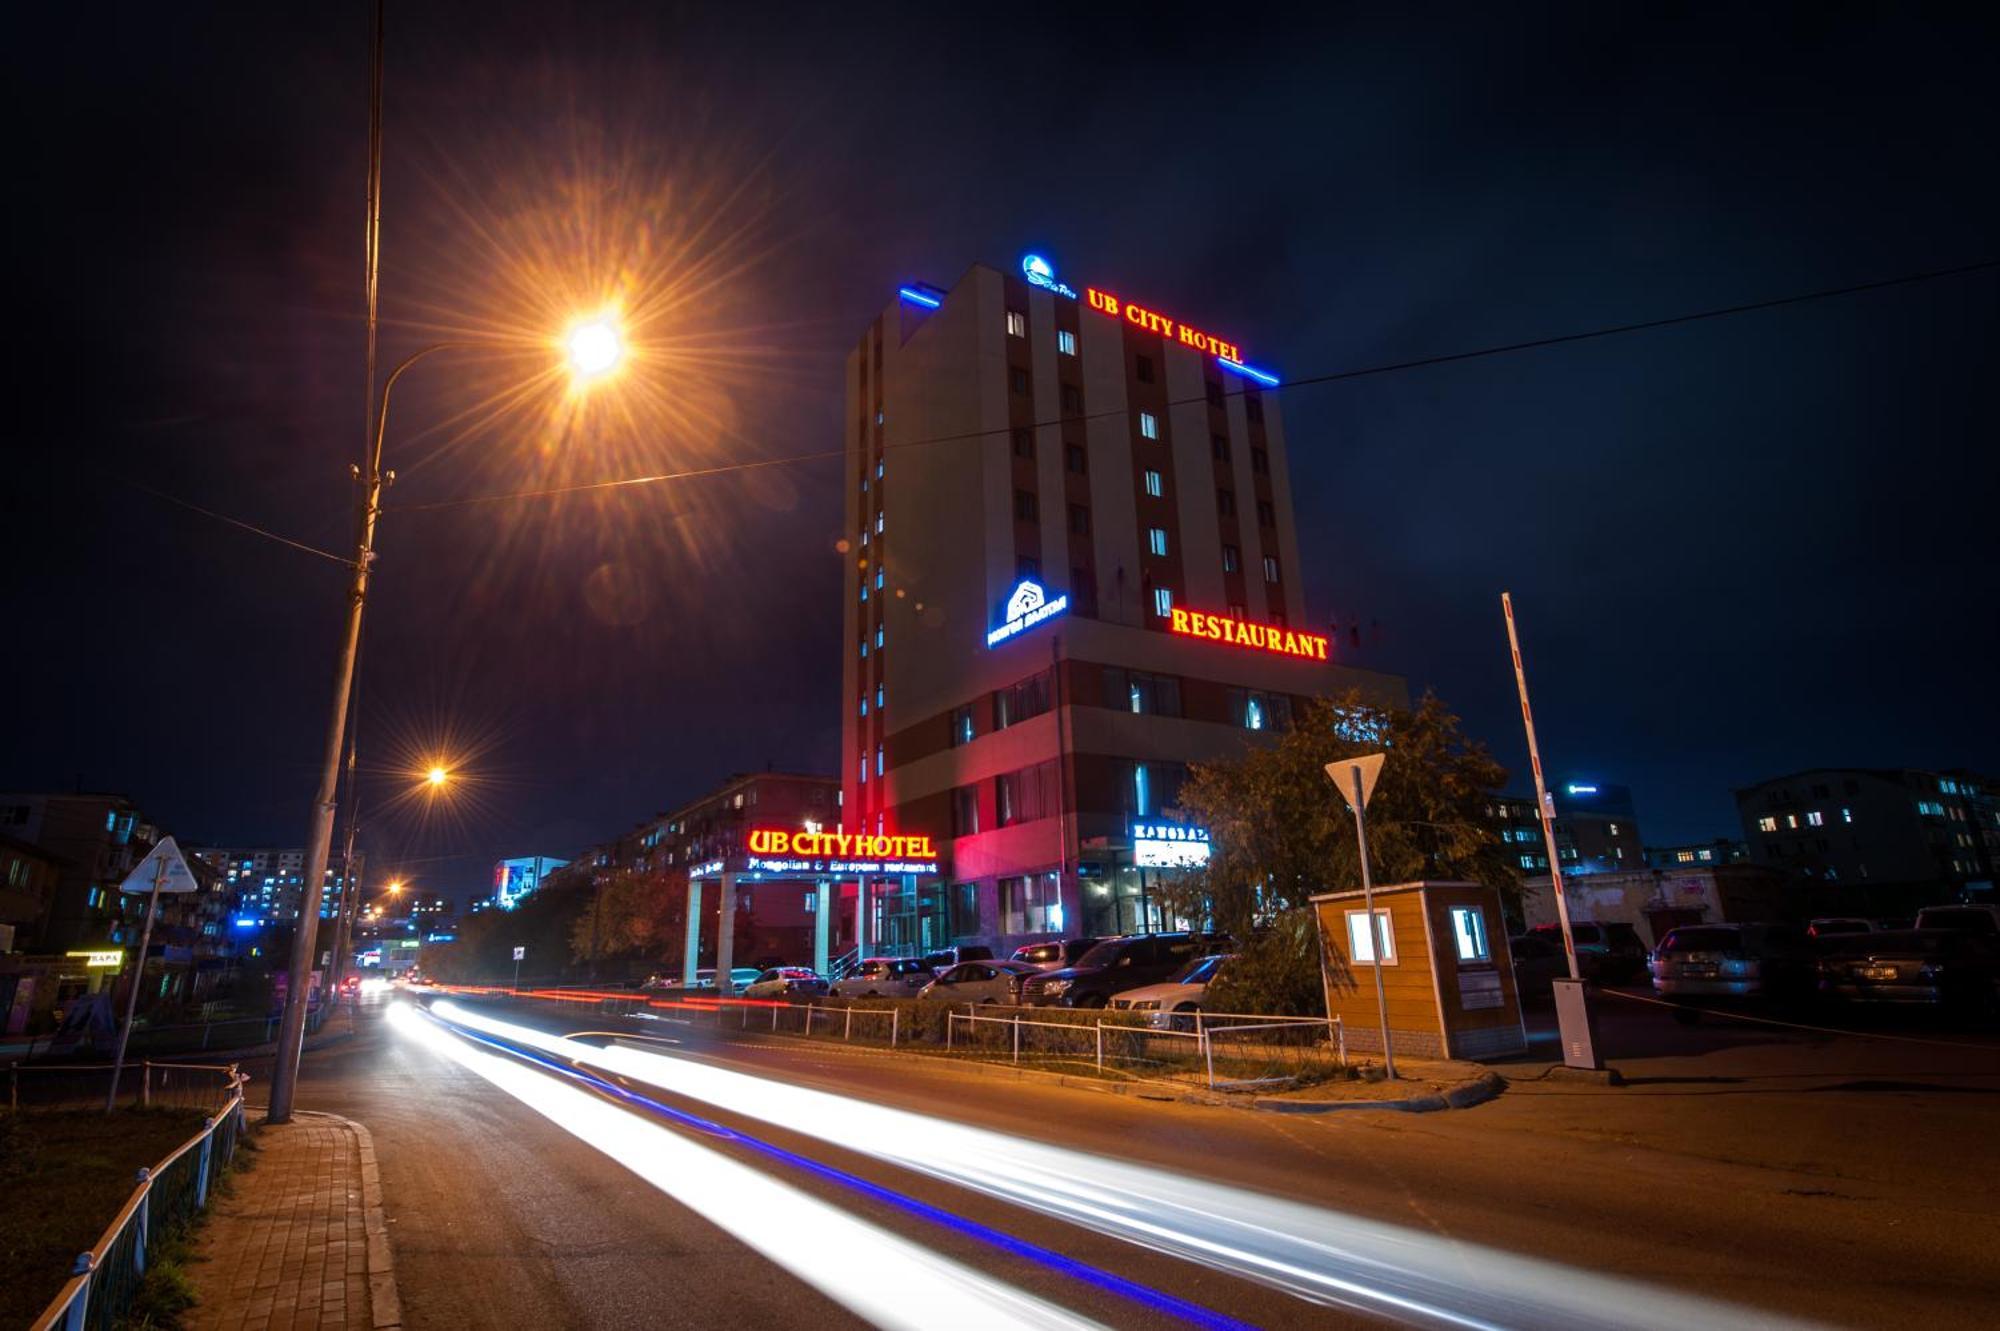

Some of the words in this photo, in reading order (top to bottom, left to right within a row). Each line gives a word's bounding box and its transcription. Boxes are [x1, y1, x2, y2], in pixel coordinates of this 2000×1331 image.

[1088, 288, 1119, 314] UB
[1126, 303, 1173, 337] CITY
[1179, 324, 1243, 364] HOTEL
[1172, 608, 1328, 660] RESTAURANT
[749, 831, 789, 853] UB
[791, 832, 853, 857] CITY
[855, 836, 936, 858] HOTEL
[748, 858, 810, 872] Mongolian
